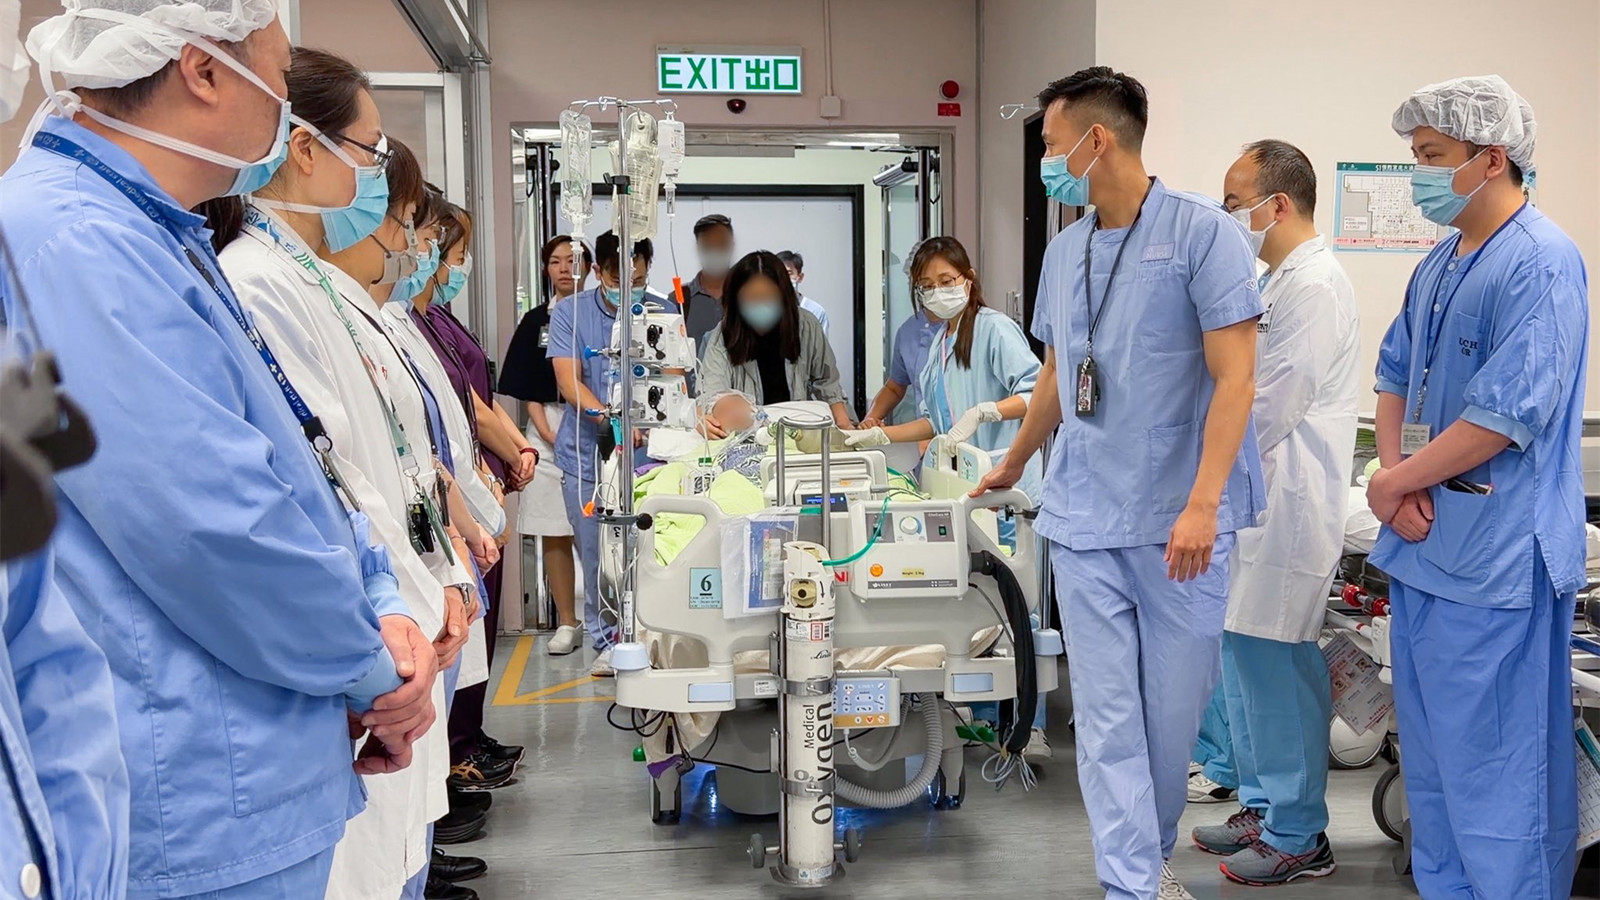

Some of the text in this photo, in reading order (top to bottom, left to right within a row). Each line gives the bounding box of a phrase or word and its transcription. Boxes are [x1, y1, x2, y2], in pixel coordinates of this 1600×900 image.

[661, 57, 741, 89] EXIT
[745, 58, 798, 90] 出口
[700, 574, 712, 591] 6
[803, 704, 815, 749] Medical
